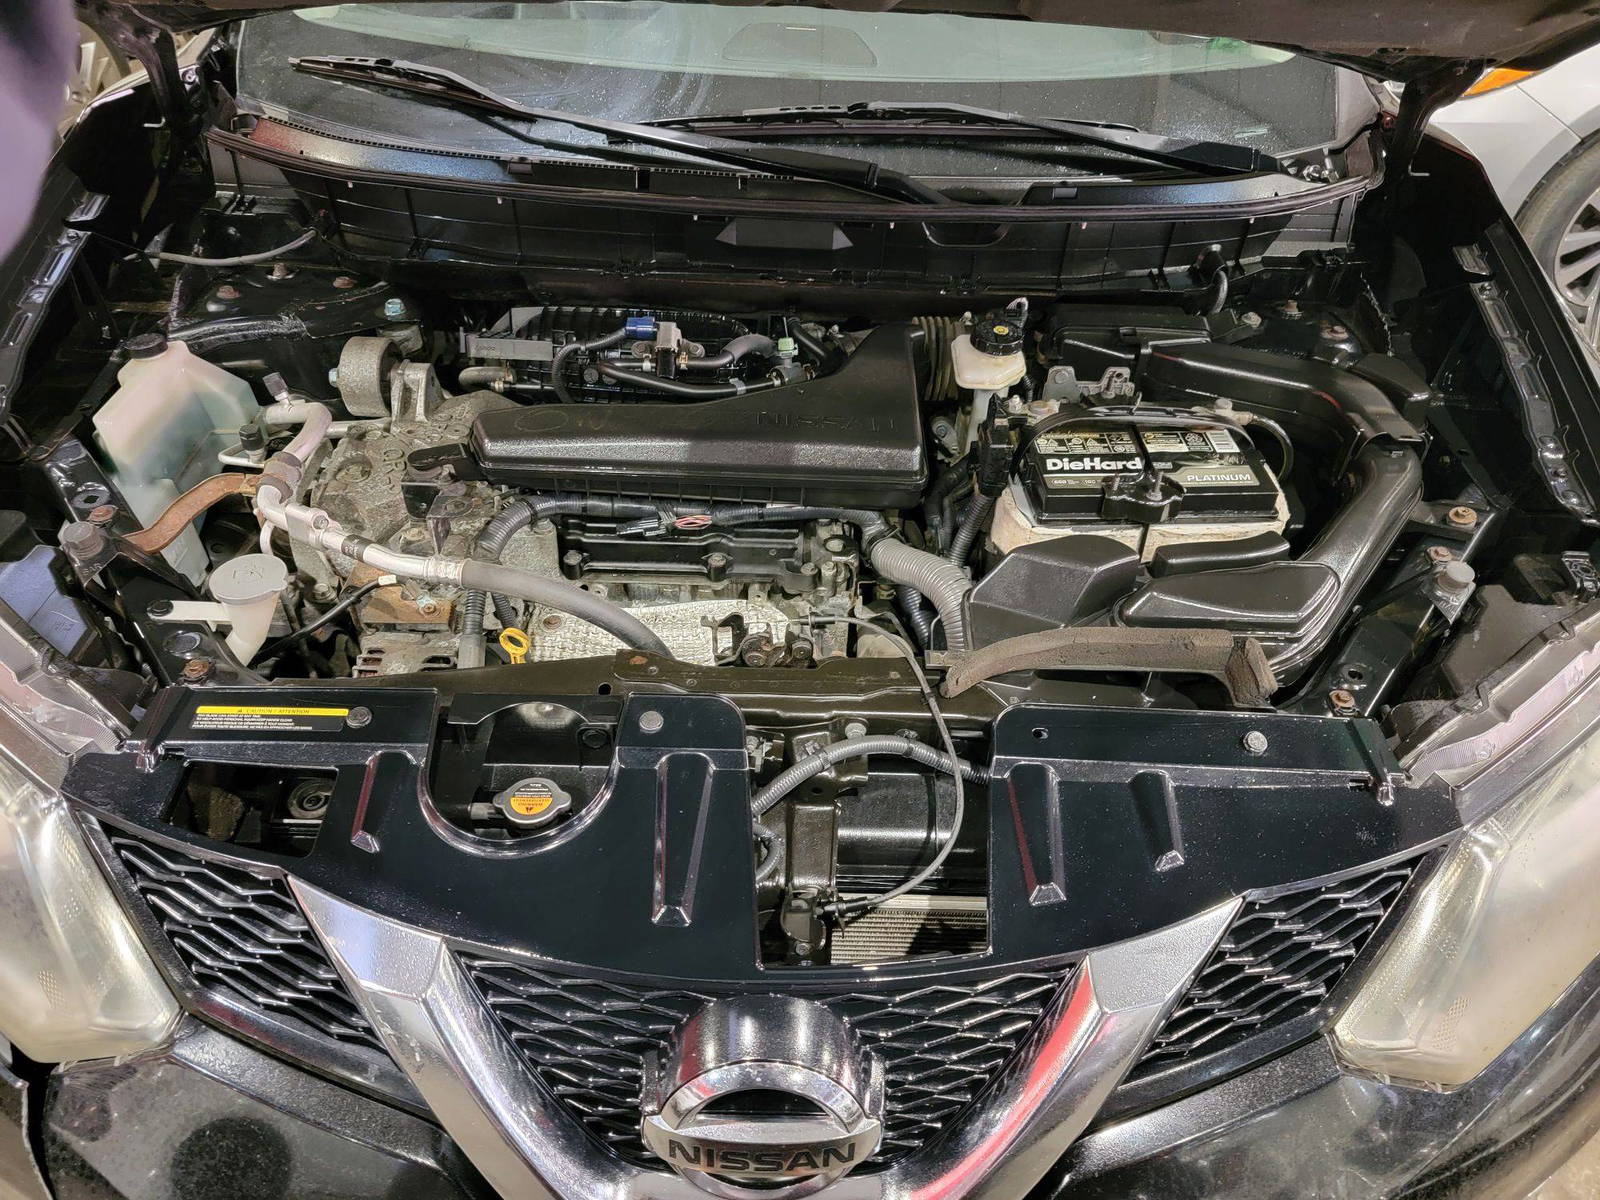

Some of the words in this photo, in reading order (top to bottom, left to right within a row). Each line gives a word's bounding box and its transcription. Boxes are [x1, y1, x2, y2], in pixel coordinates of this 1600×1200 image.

[1046, 456, 1143, 471] DieHard
[1186, 474, 1251, 482] PLATINUM
[668, 1138, 856, 1172] NISSAN
